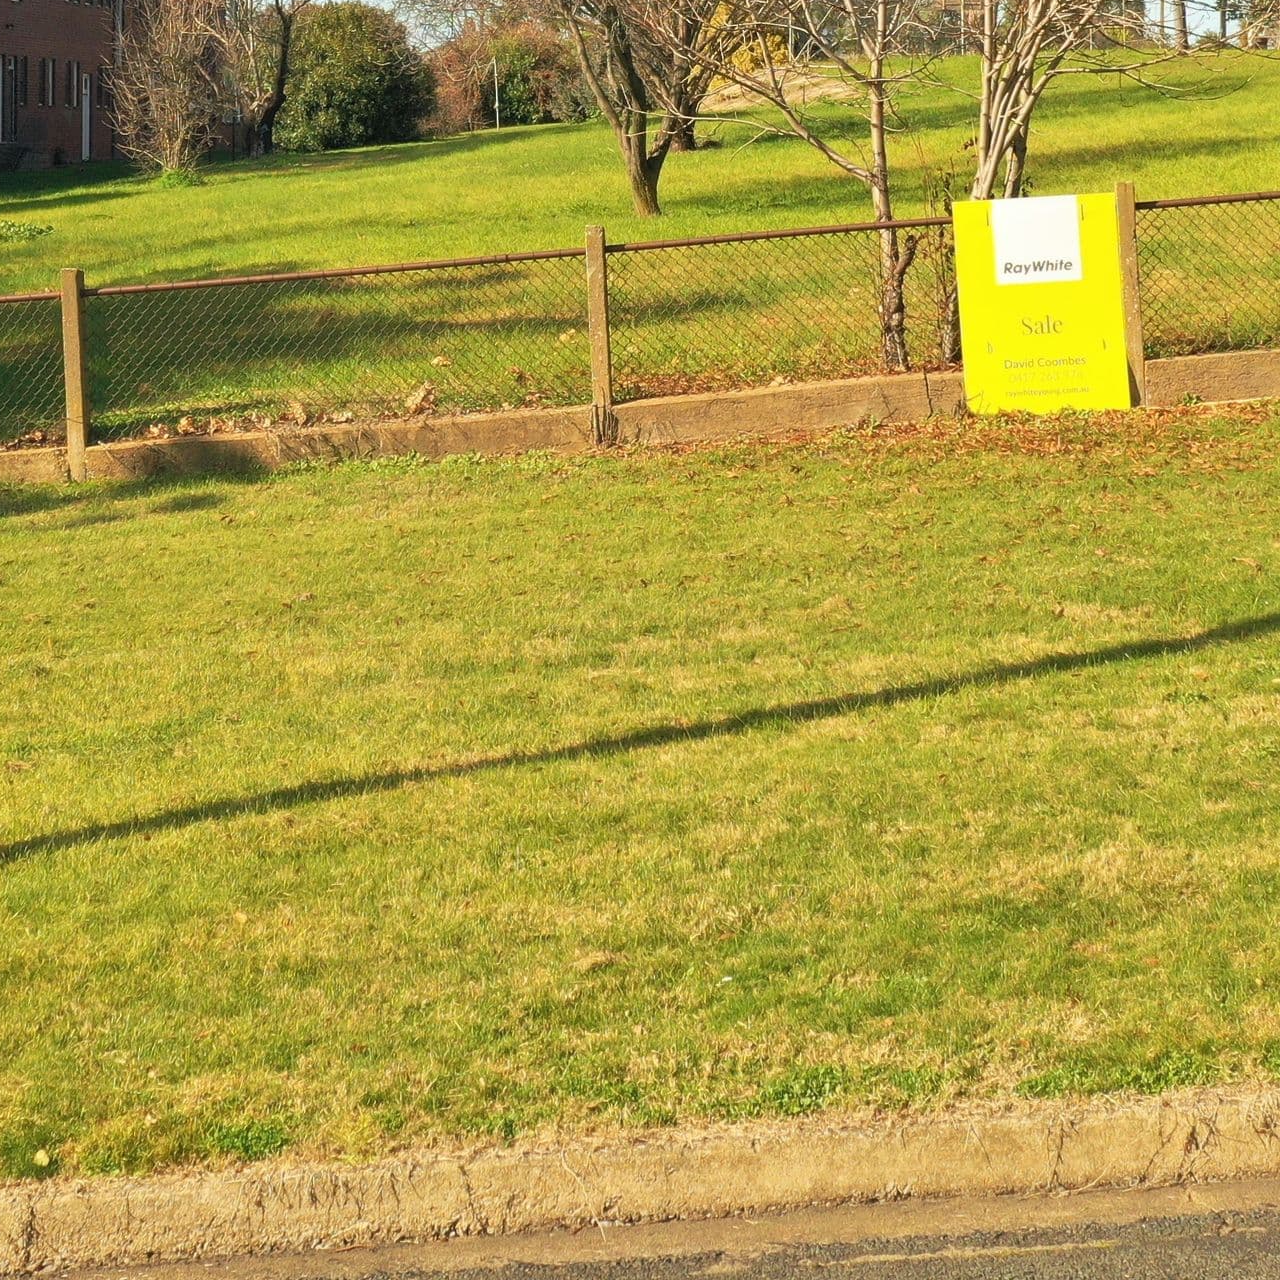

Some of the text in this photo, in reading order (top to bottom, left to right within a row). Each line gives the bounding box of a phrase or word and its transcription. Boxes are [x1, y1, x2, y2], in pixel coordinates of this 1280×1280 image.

[1021, 315, 1063, 336] Sale
[1004, 356, 1086, 369] David Coombes
